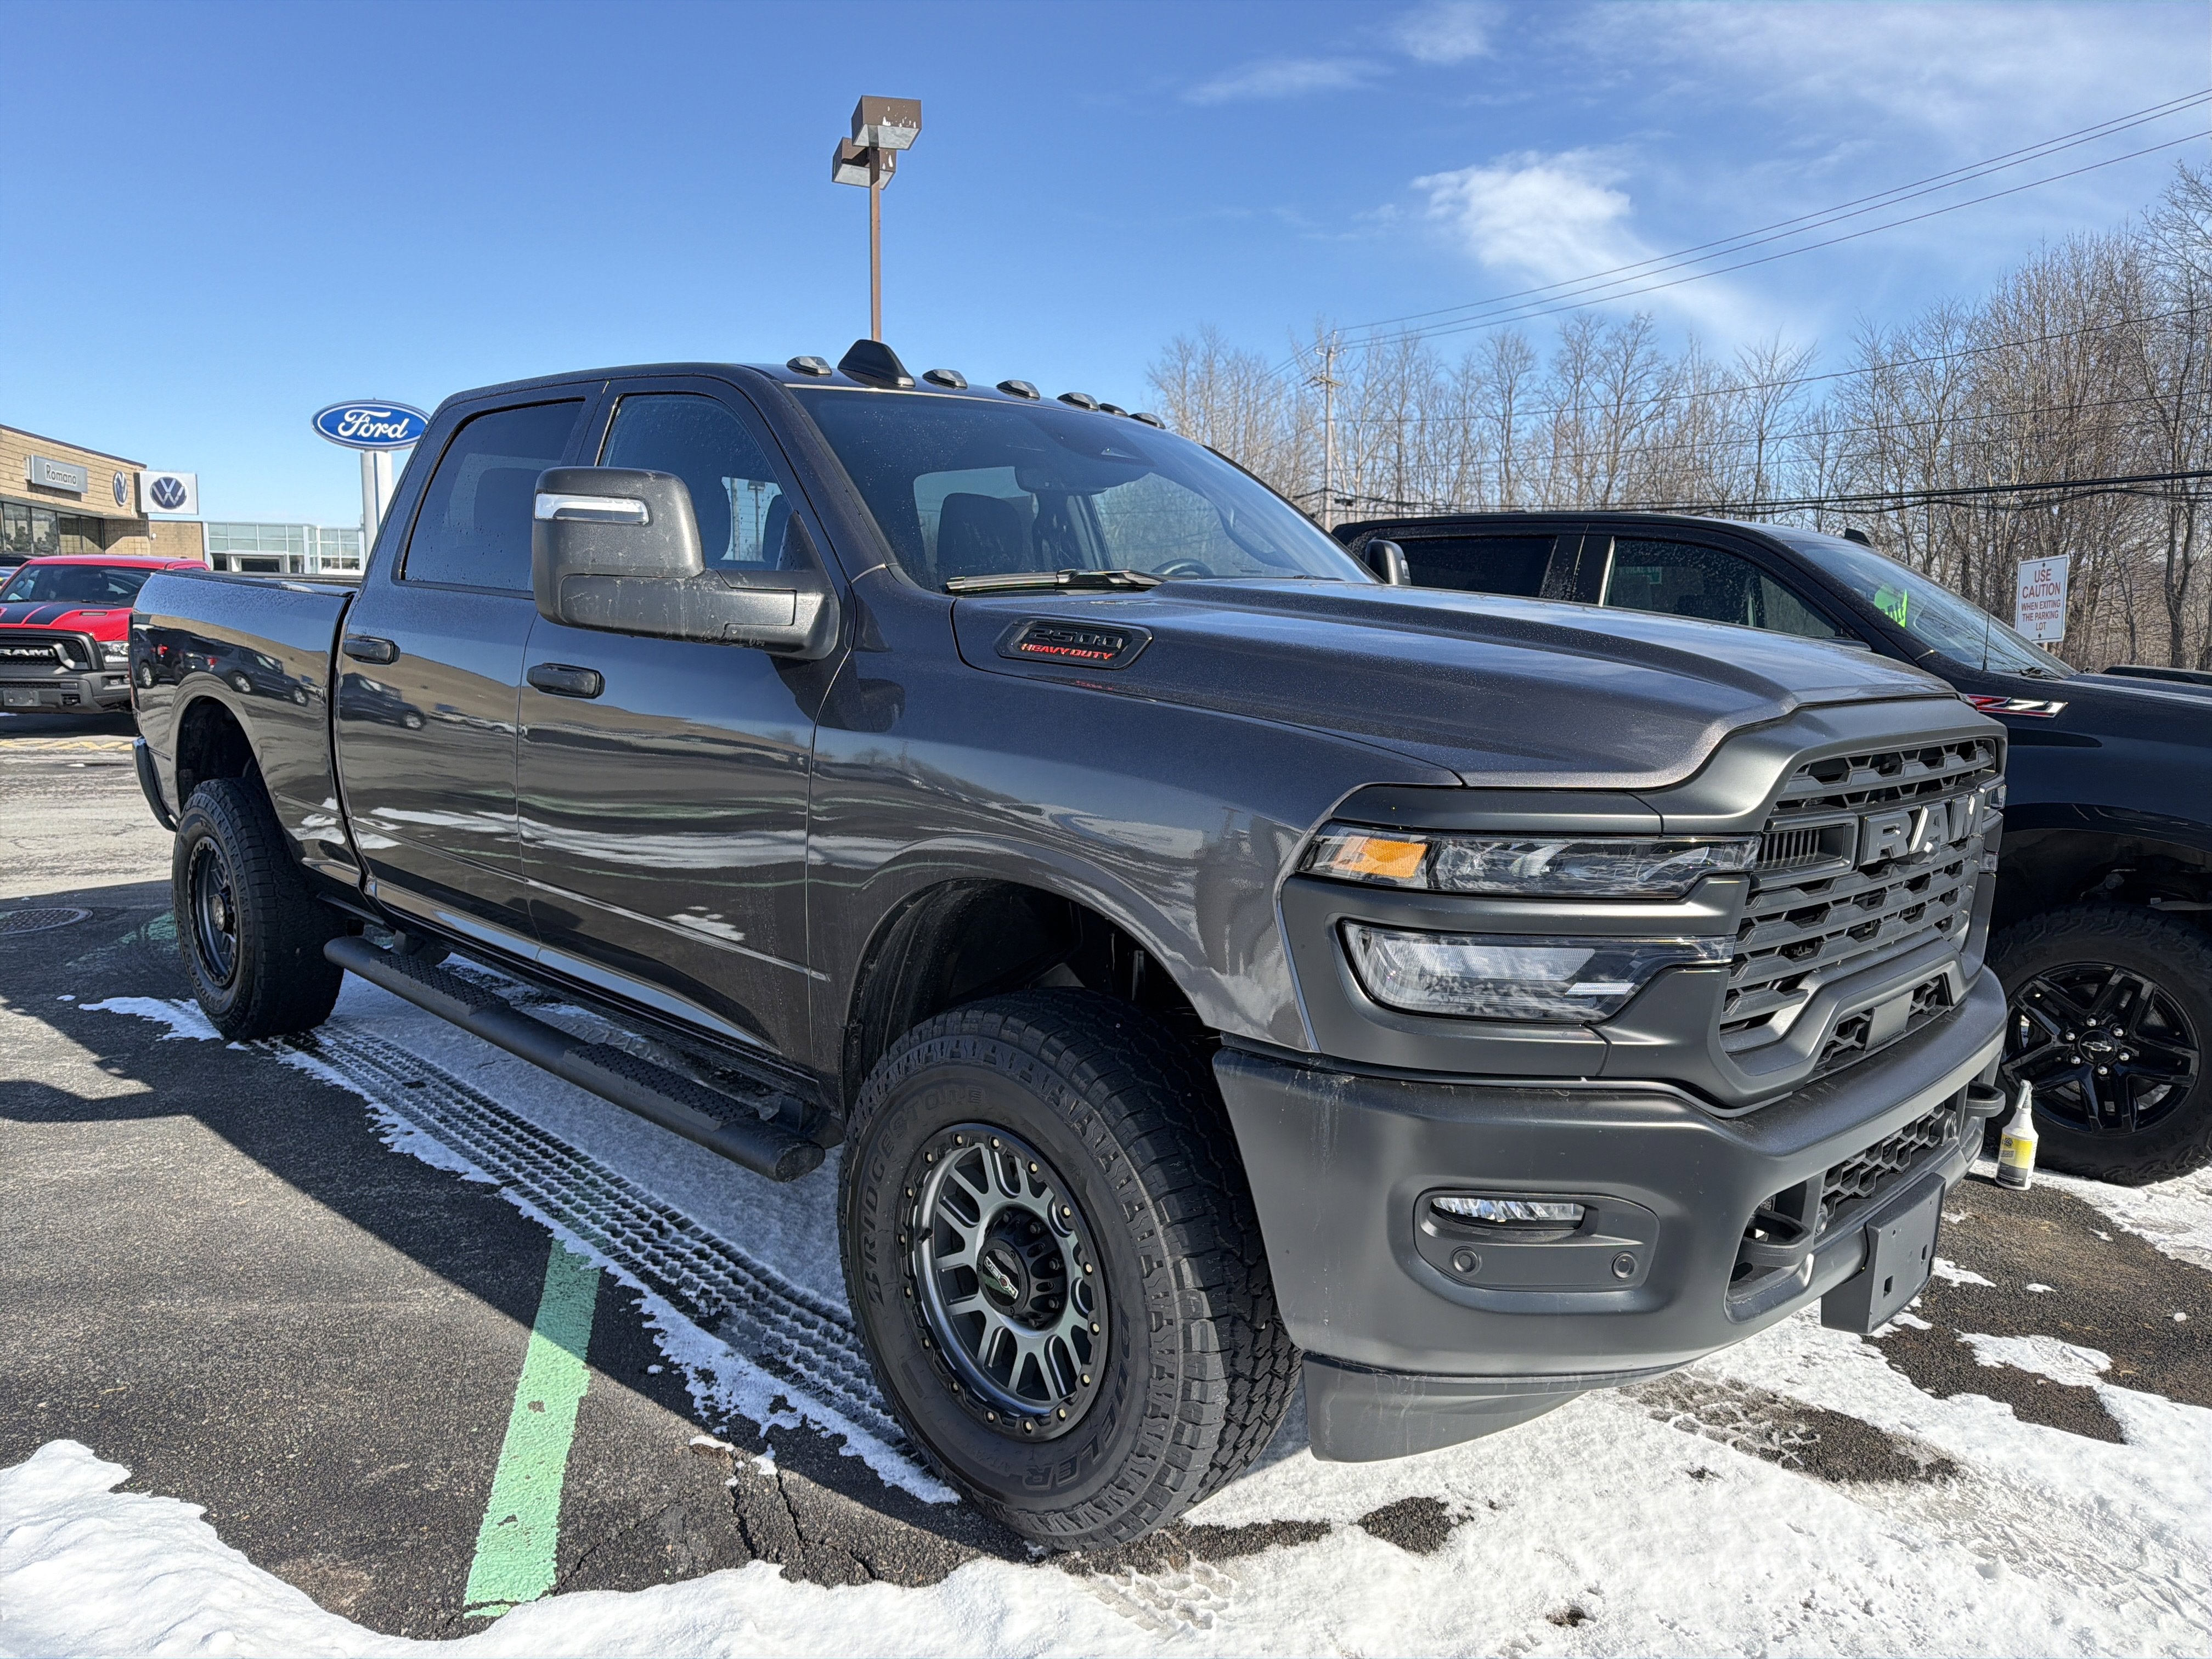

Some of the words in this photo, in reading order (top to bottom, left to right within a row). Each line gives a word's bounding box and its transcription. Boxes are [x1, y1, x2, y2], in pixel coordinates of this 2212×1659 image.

[337, 409, 409, 438] Ford
[46, 464, 77, 485] Romano
[2034, 568, 2052, 583] USE
[2022, 582, 2061, 599] CAUTION
[2021, 601, 2038, 611] WHEN
[2039, 599, 2061, 609] EXITING
[2022, 613, 2034, 622] THE
[2035, 610, 2058, 620] PARKING
[2036, 622, 2046, 631] LOT
[1029, 629, 1123, 650] 2500
[1021, 643, 1069, 655] HEAVY
[1070, 648, 1115, 659] DUTY
[1861, 794, 1985, 866] RAM
[985, 1258, 1017, 1296] VISION
[1022, 1305, 1132, 1491] DUELER
